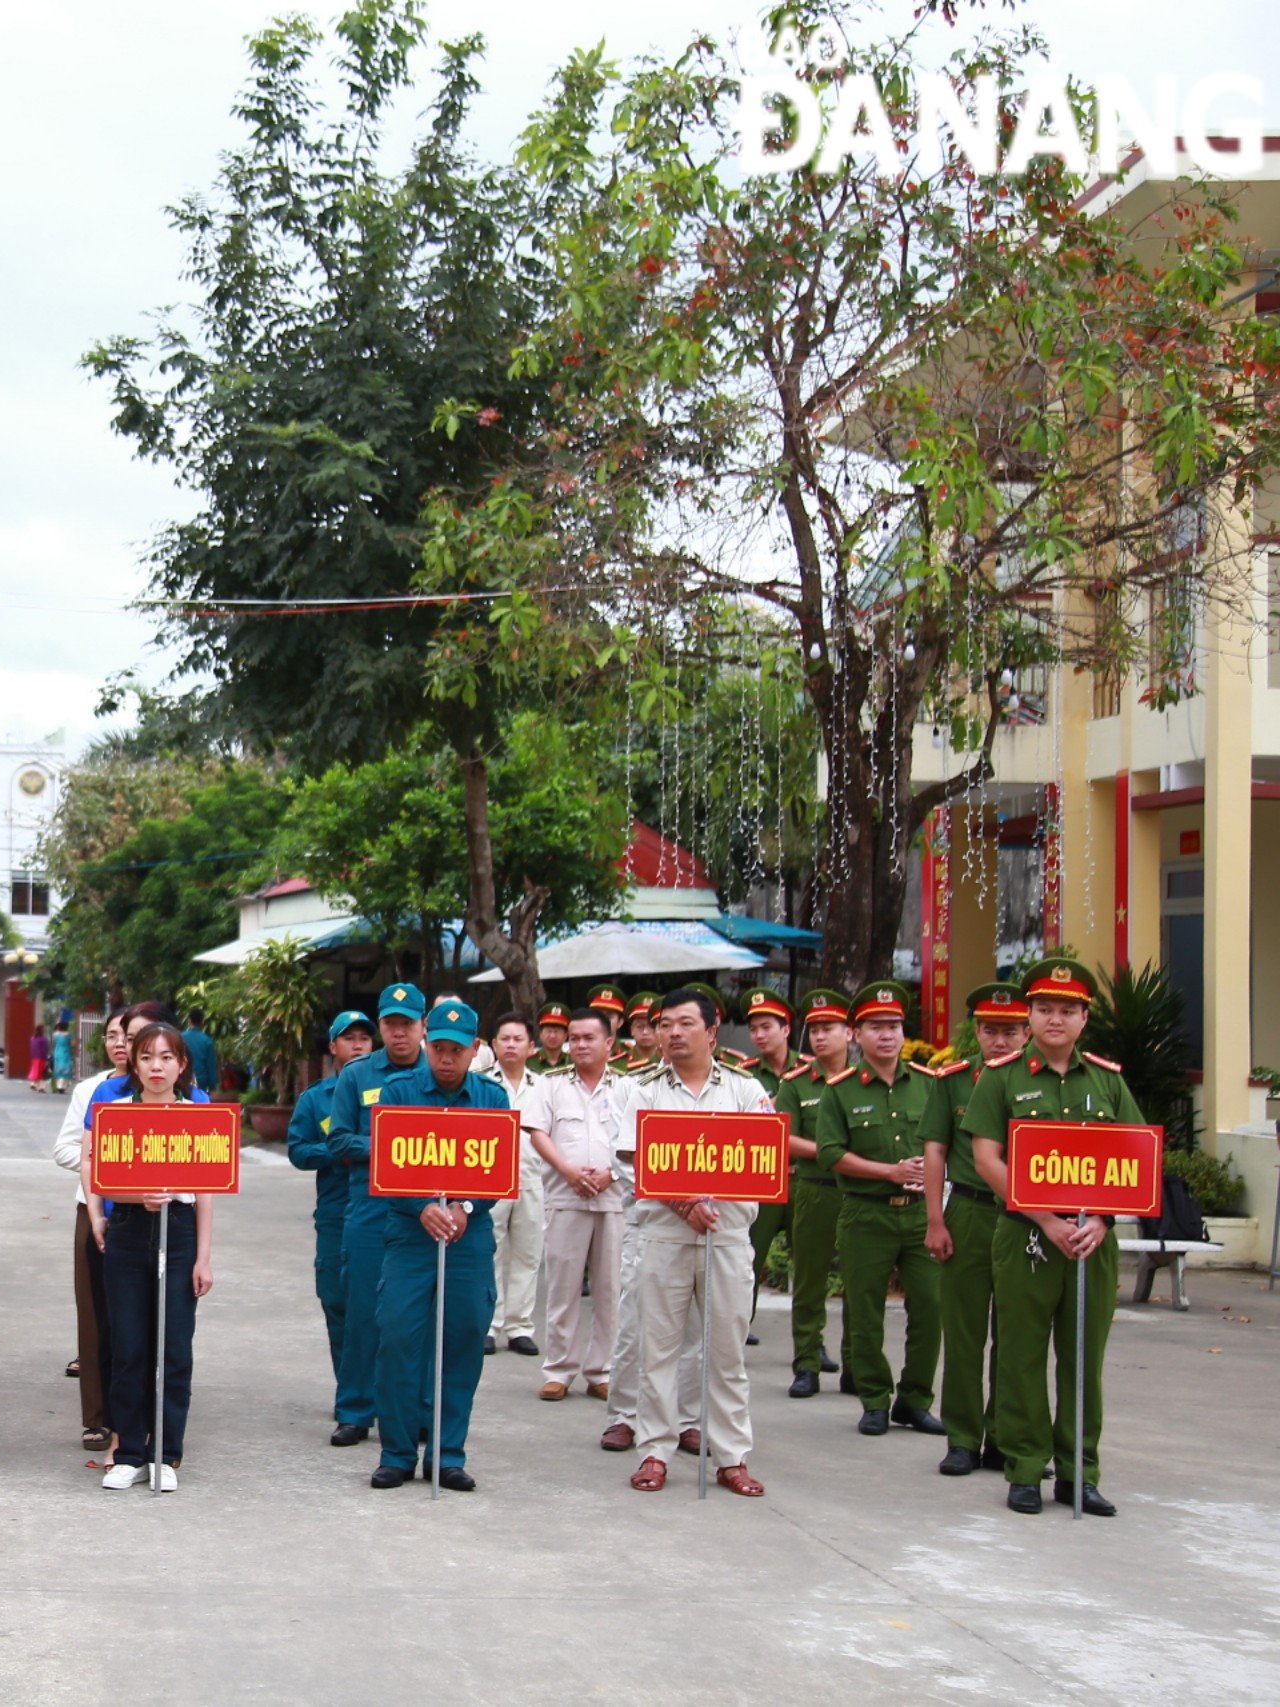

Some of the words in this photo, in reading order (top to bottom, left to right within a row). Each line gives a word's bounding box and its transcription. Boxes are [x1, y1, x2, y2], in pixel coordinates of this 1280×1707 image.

[100, 1127, 120, 1163] CÁN
[121, 1127, 134, 1169] BỘ
[141, 1127, 167, 1164] CÔNG
[168, 1127, 192, 1164] CHỨC
[193, 1127, 231, 1164] PHƯỜNG
[391, 1131, 457, 1168] QUÂN
[463, 1136, 499, 1175] SỰ
[647, 1142, 681, 1174] QUY
[685, 1132, 718, 1173] TẮC
[722, 1138, 745, 1173] ĐÔ
[750, 1145, 777, 1181] THỊ
[1030, 1149, 1096, 1185] CÔNG
[1103, 1157, 1138, 1187] AN
